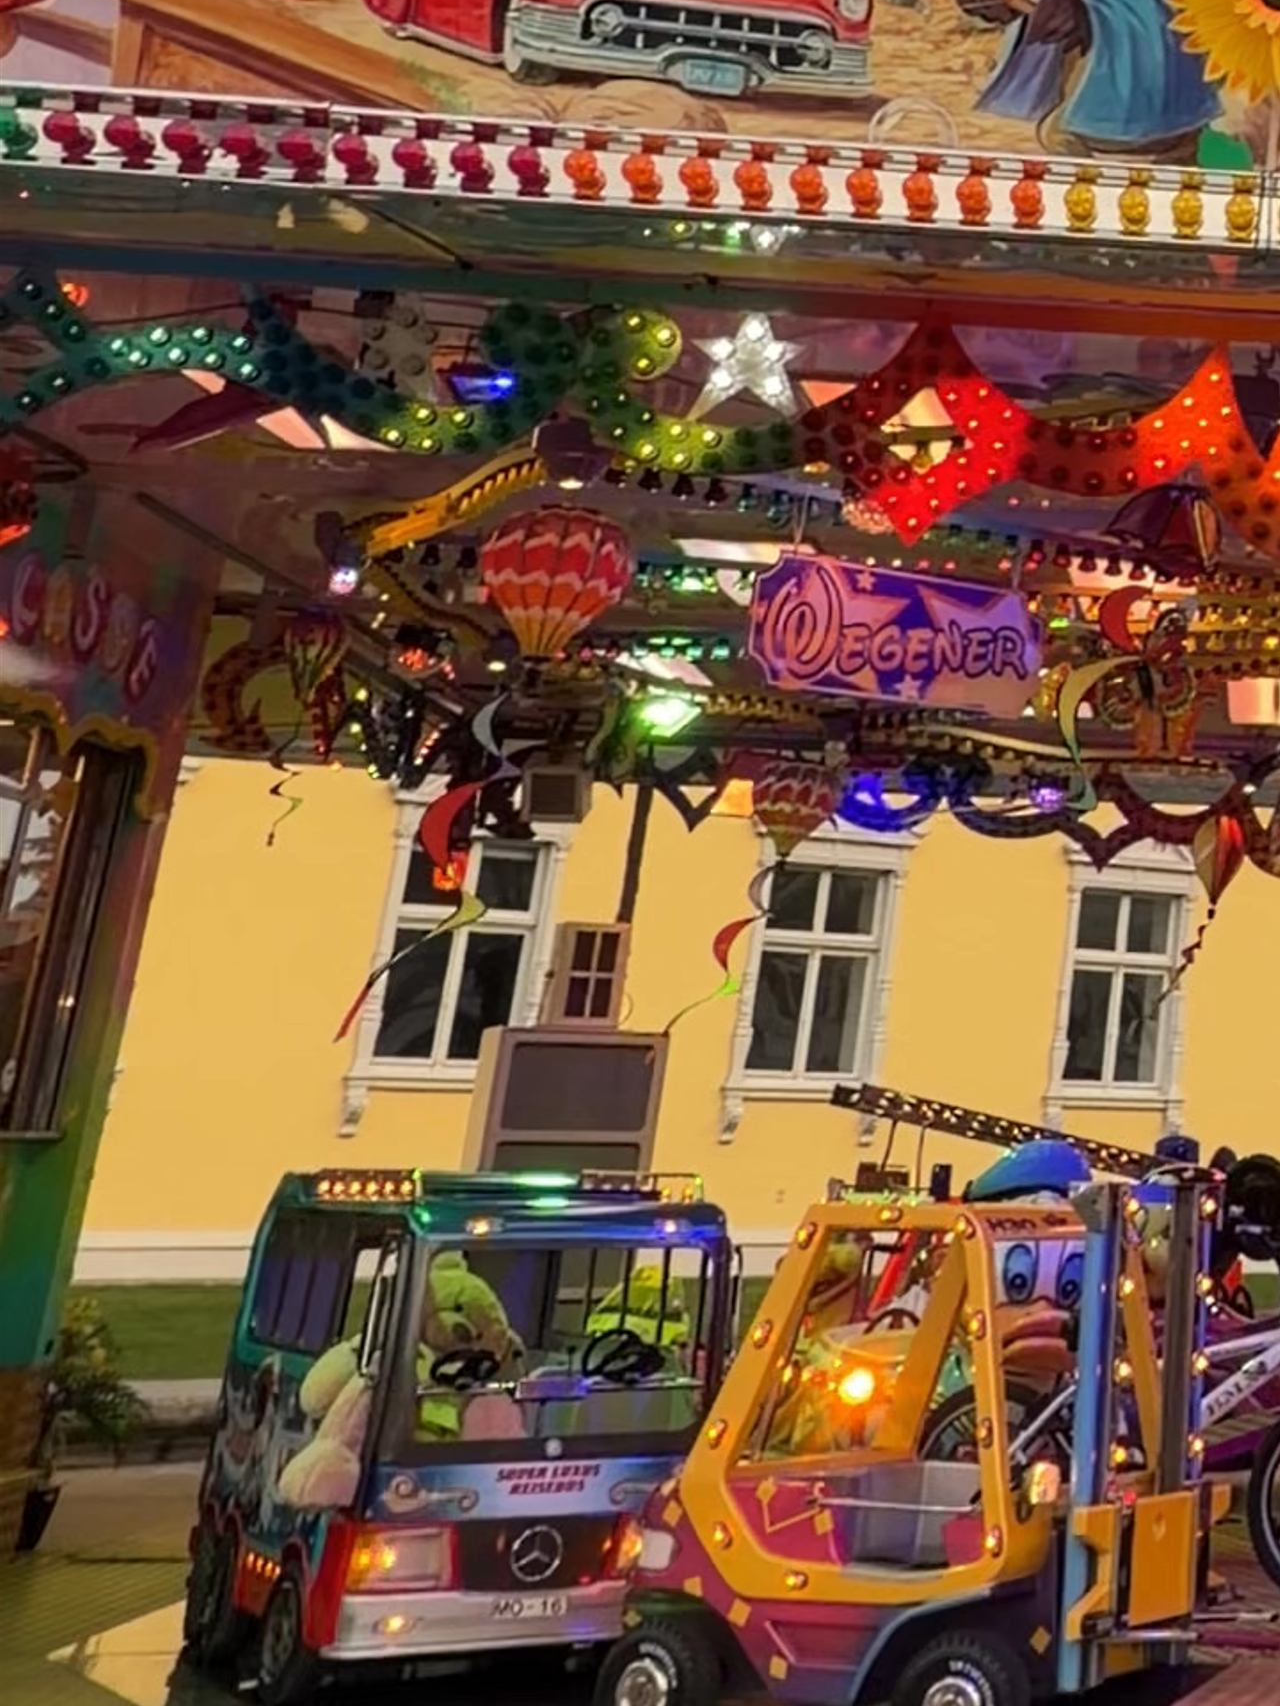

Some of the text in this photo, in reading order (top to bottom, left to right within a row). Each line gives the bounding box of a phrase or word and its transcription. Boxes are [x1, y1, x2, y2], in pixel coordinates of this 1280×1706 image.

[763, 564, 1028, 680] WEGENER
[497, 1464, 601, 1482] SUPER LUXUS
[509, 1481, 585, 1495] REISEBUS
